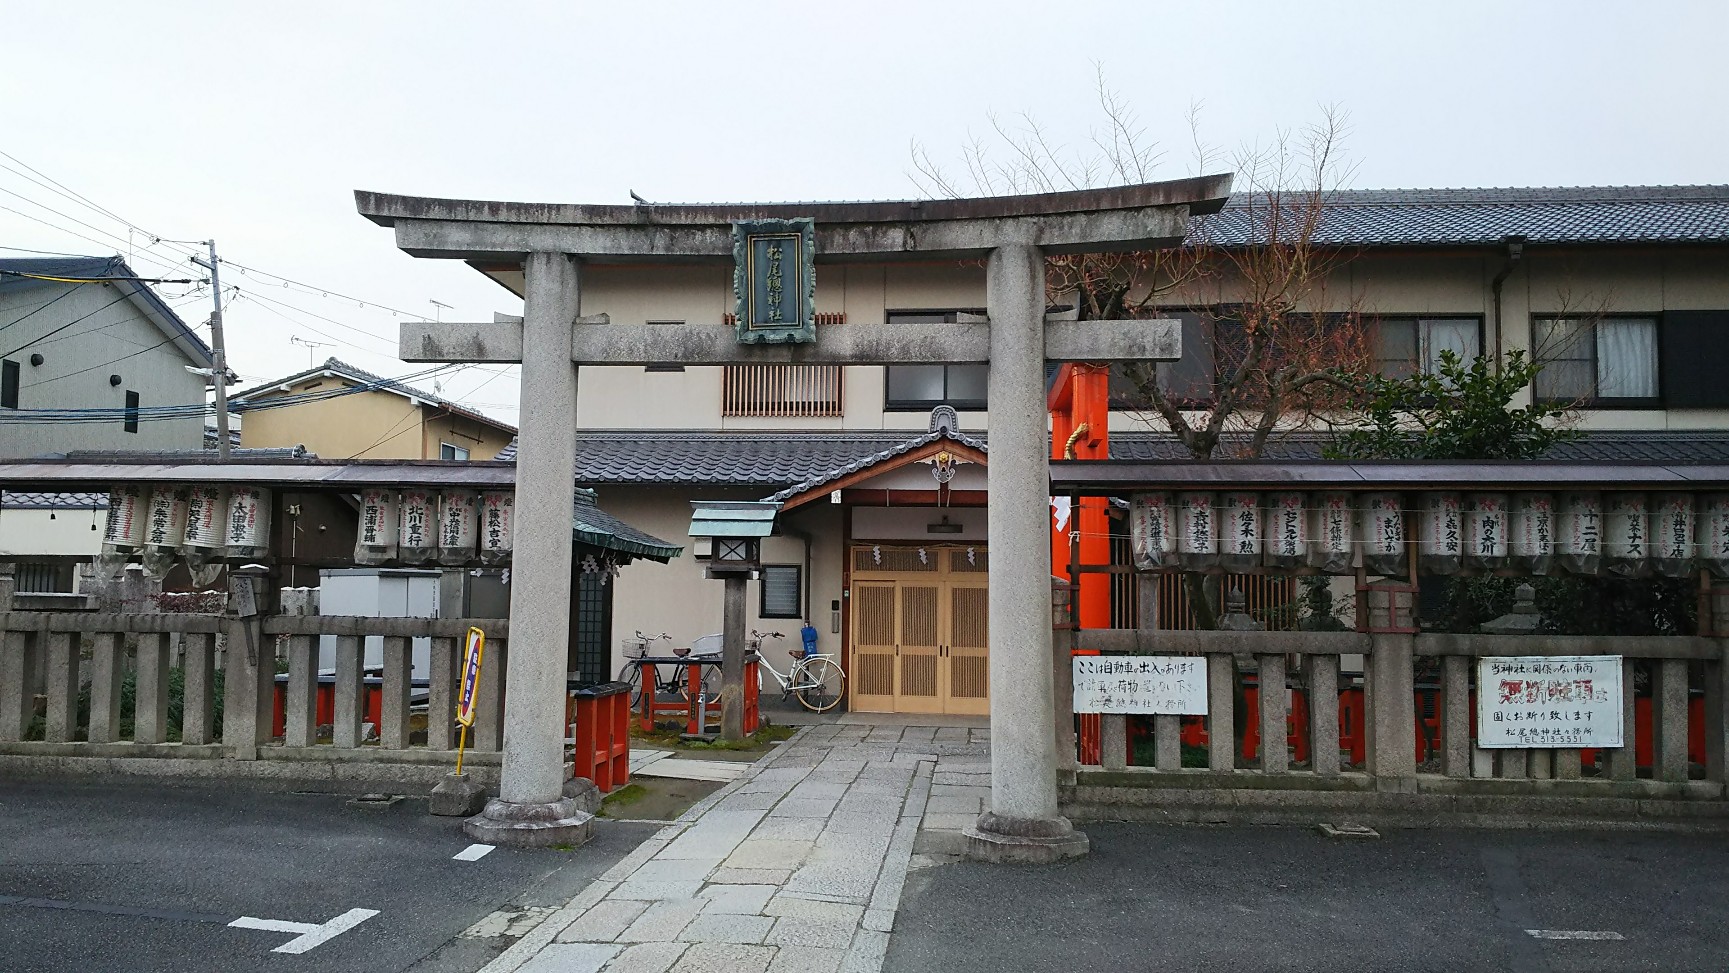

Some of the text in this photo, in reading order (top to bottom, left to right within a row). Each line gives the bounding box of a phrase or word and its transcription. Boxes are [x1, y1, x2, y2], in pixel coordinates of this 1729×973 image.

[408, 505, 424, 546] 北川重行
[1493, 711, 1593, 722] 固くお断り致します
